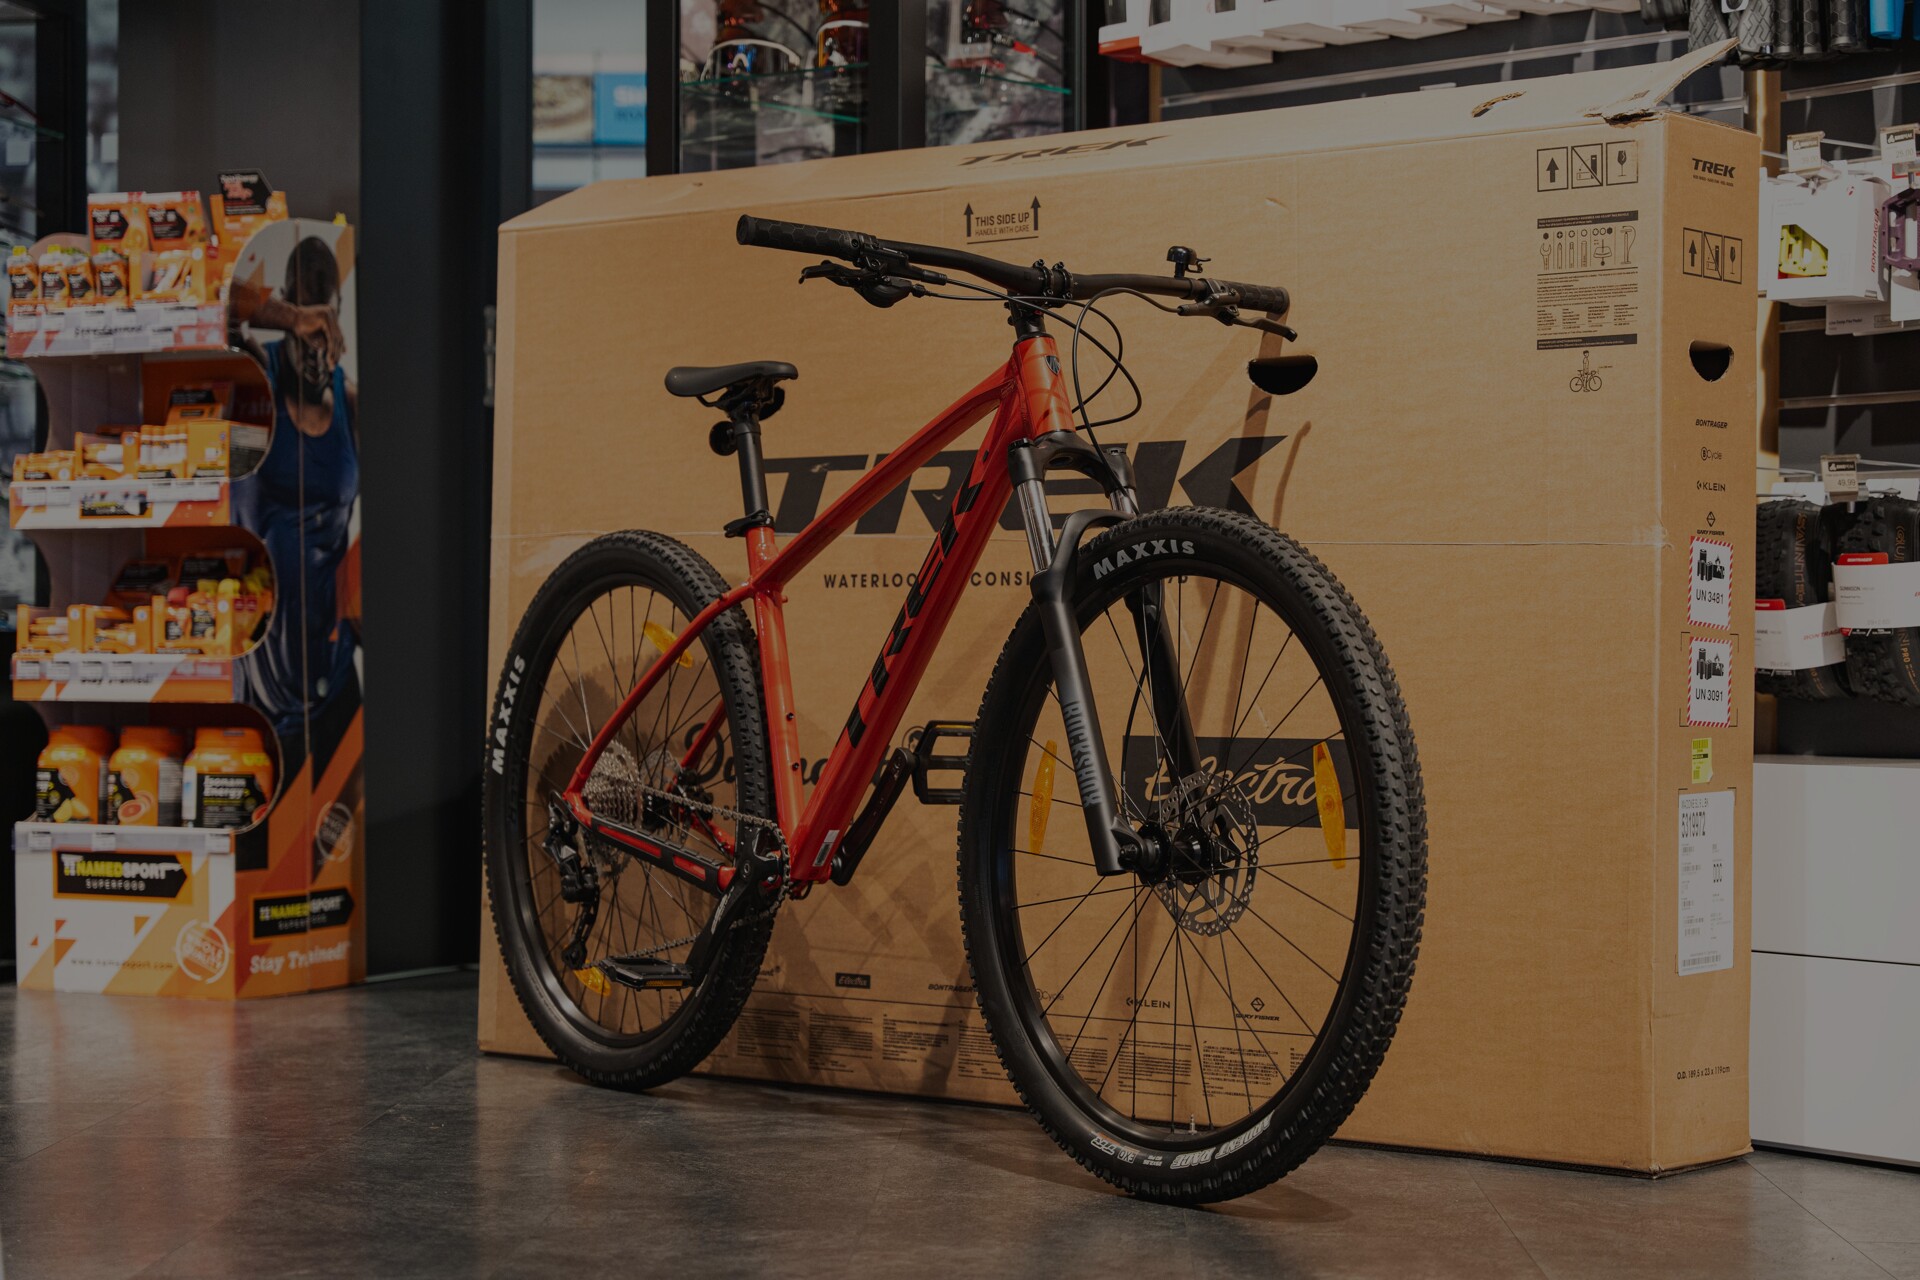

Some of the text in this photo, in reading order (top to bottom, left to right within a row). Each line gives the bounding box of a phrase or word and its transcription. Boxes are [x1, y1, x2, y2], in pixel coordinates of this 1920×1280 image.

[959, 135, 1170, 166] TREK
[1692, 158, 1736, 178] TREK
[975, 212, 1030, 227] THIS SIDE UP
[975, 224, 1030, 236] HANDLE WITH CARE
[1871, 208, 1880, 273] BONTRAGER
[1695, 419, 1728, 429] BONTRAGER
[1702, 481, 1726, 492] KLEIN
[1092, 539, 1196, 580] MAXXIS
[1696, 588, 1724, 605] UN 3481
[1695, 687, 1723, 703] UN 3091
[492, 654, 526, 775] MAXXIS
[1063, 701, 1103, 808] ROCKSHOX
[85, 878, 146, 891] SUPERFOOD
[250, 954, 285, 975] Stay
[928, 983, 974, 993] BONTRAGER
[1136, 998, 1171, 1009] KLEIN
[1255, 1014, 1280, 1022] FISHER
